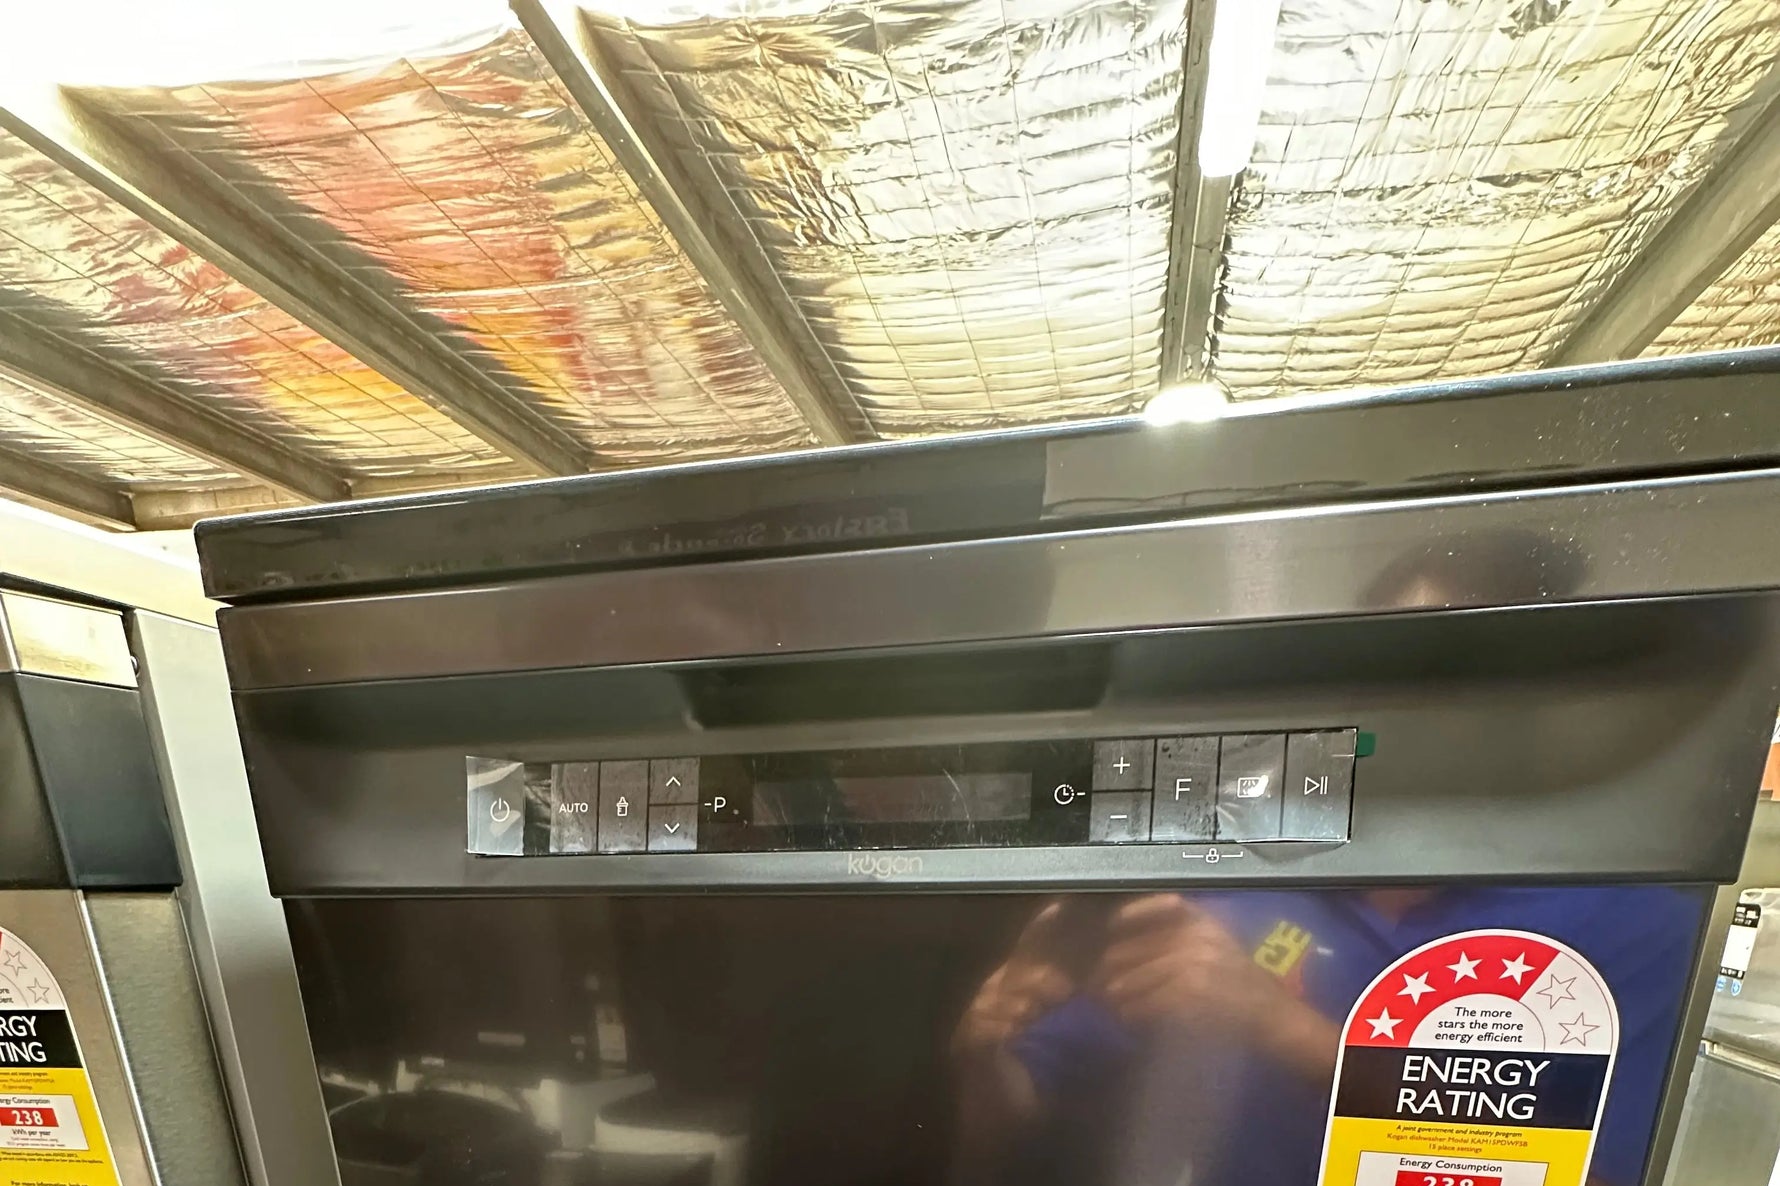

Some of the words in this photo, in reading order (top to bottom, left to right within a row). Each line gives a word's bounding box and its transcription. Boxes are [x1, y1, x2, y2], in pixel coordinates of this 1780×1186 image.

[1175, 778, 1192, 801] F
[559, 803, 588, 813] AUTO
[714, 797, 727, 813] P
[847, 853, 923, 879] kogan
[1454, 1006, 1476, 1018] The
[1479, 1008, 1512, 1019] more
[1438, 1019, 1467, 1030] stars
[1470, 1019, 1489, 1030] the
[1491, 1021, 1524, 1032] more
[1434, 1032, 1474, 1044] energy
[1476, 1031, 1523, 1043] efficient
[1402, 1055, 1551, 1087] ENERGY
[1396, 1088, 1537, 1120] RATING
[11, 1109, 44, 1126] 238
[1386, 1132, 1408, 1142] Kogan
[1409, 1133, 1447, 1143] dishwasher
[1447, 1136, 1469, 1144] Model
[1402, 1124, 1417, 1133] joint
[1417, 1125, 1454, 1135] government
[1469, 1128, 1494, 1138] industry
[1494, 1130, 1523, 1139] program
[1437, 1144, 1455, 1153] place
[1399, 1157, 1433, 1170] Energy
[1435, 1159, 1502, 1173] Consumption
